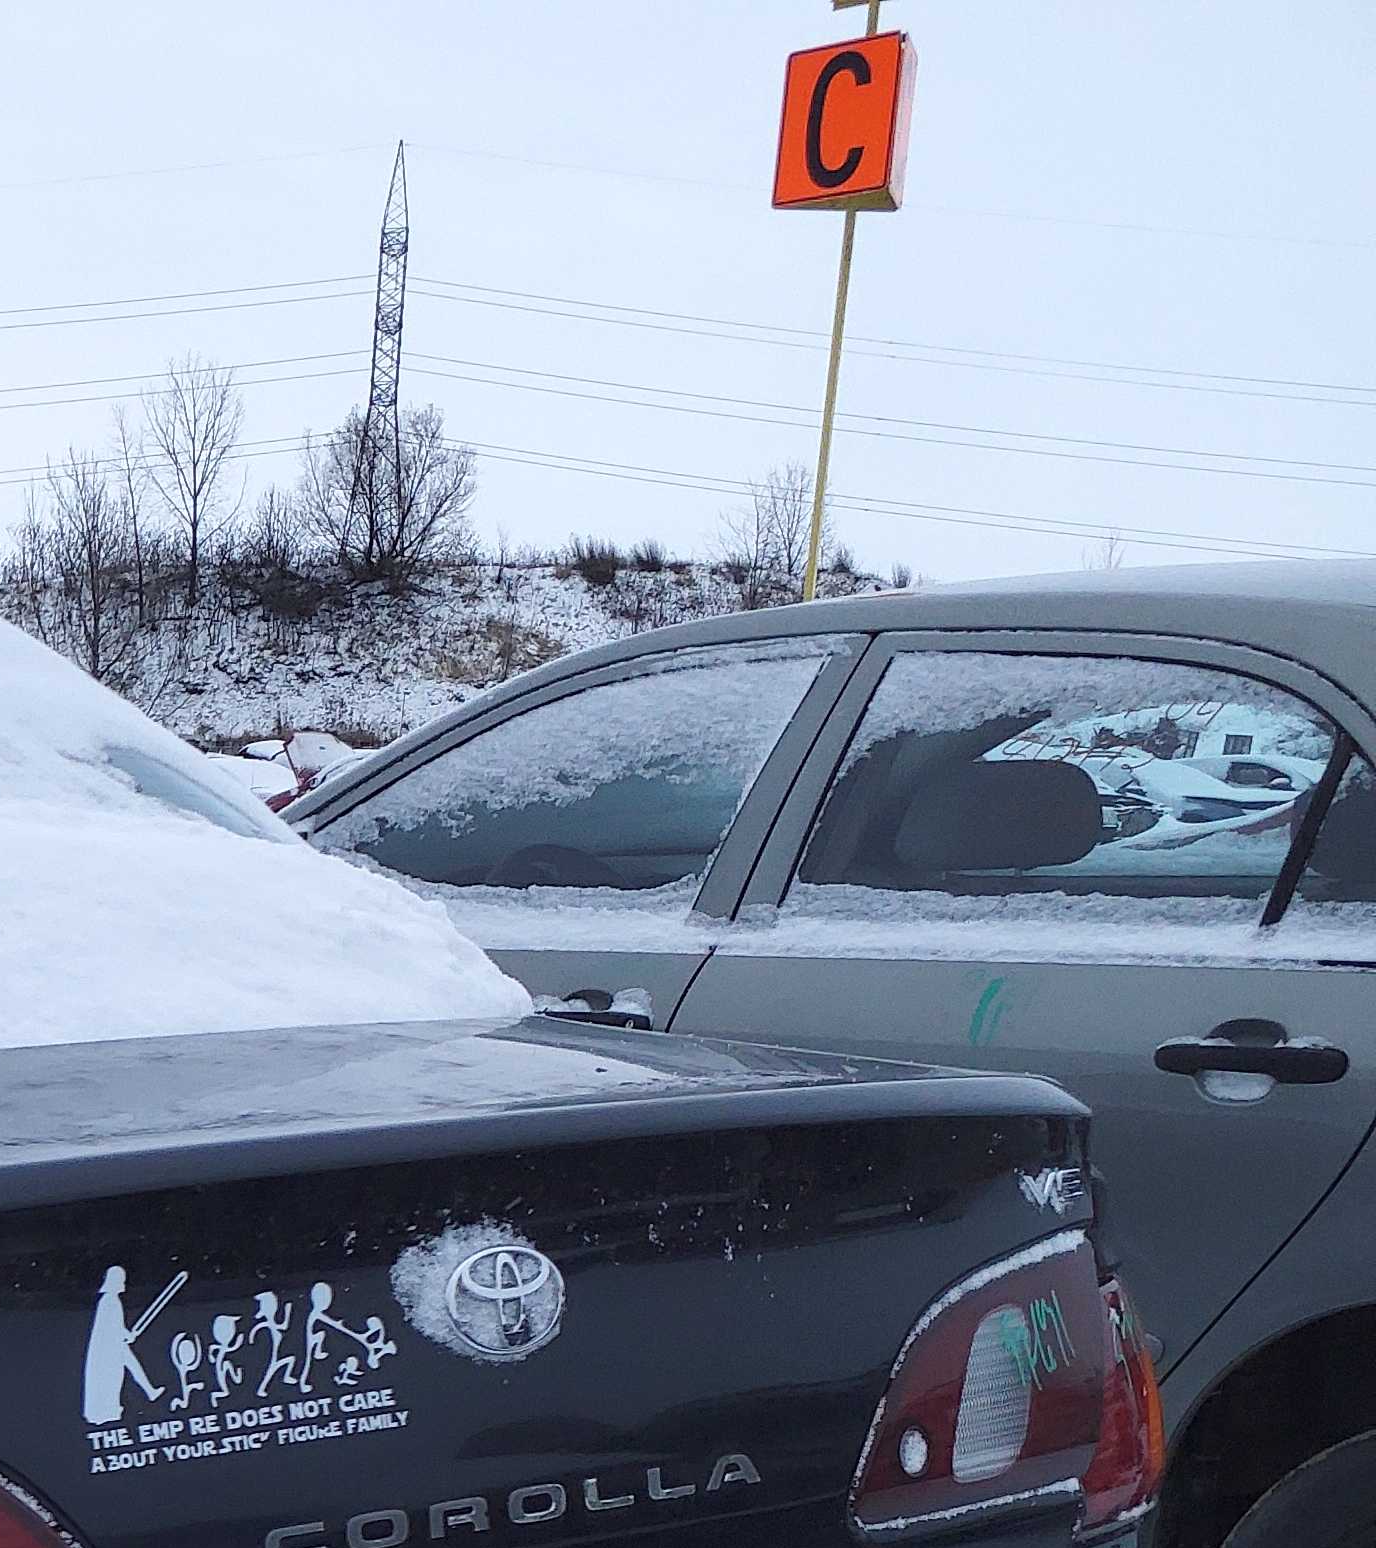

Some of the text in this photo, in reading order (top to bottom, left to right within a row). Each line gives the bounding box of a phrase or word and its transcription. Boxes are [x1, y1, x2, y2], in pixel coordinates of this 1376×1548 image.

[805, 50, 872, 189] C
[87, 1388, 397, 1450] THE EMPRE DOES NOT CARE
[90, 1450, 157, 1474] ABOUT
[162, 1440, 216, 1462] YOUR
[346, 1410, 410, 1434] FAMILY
